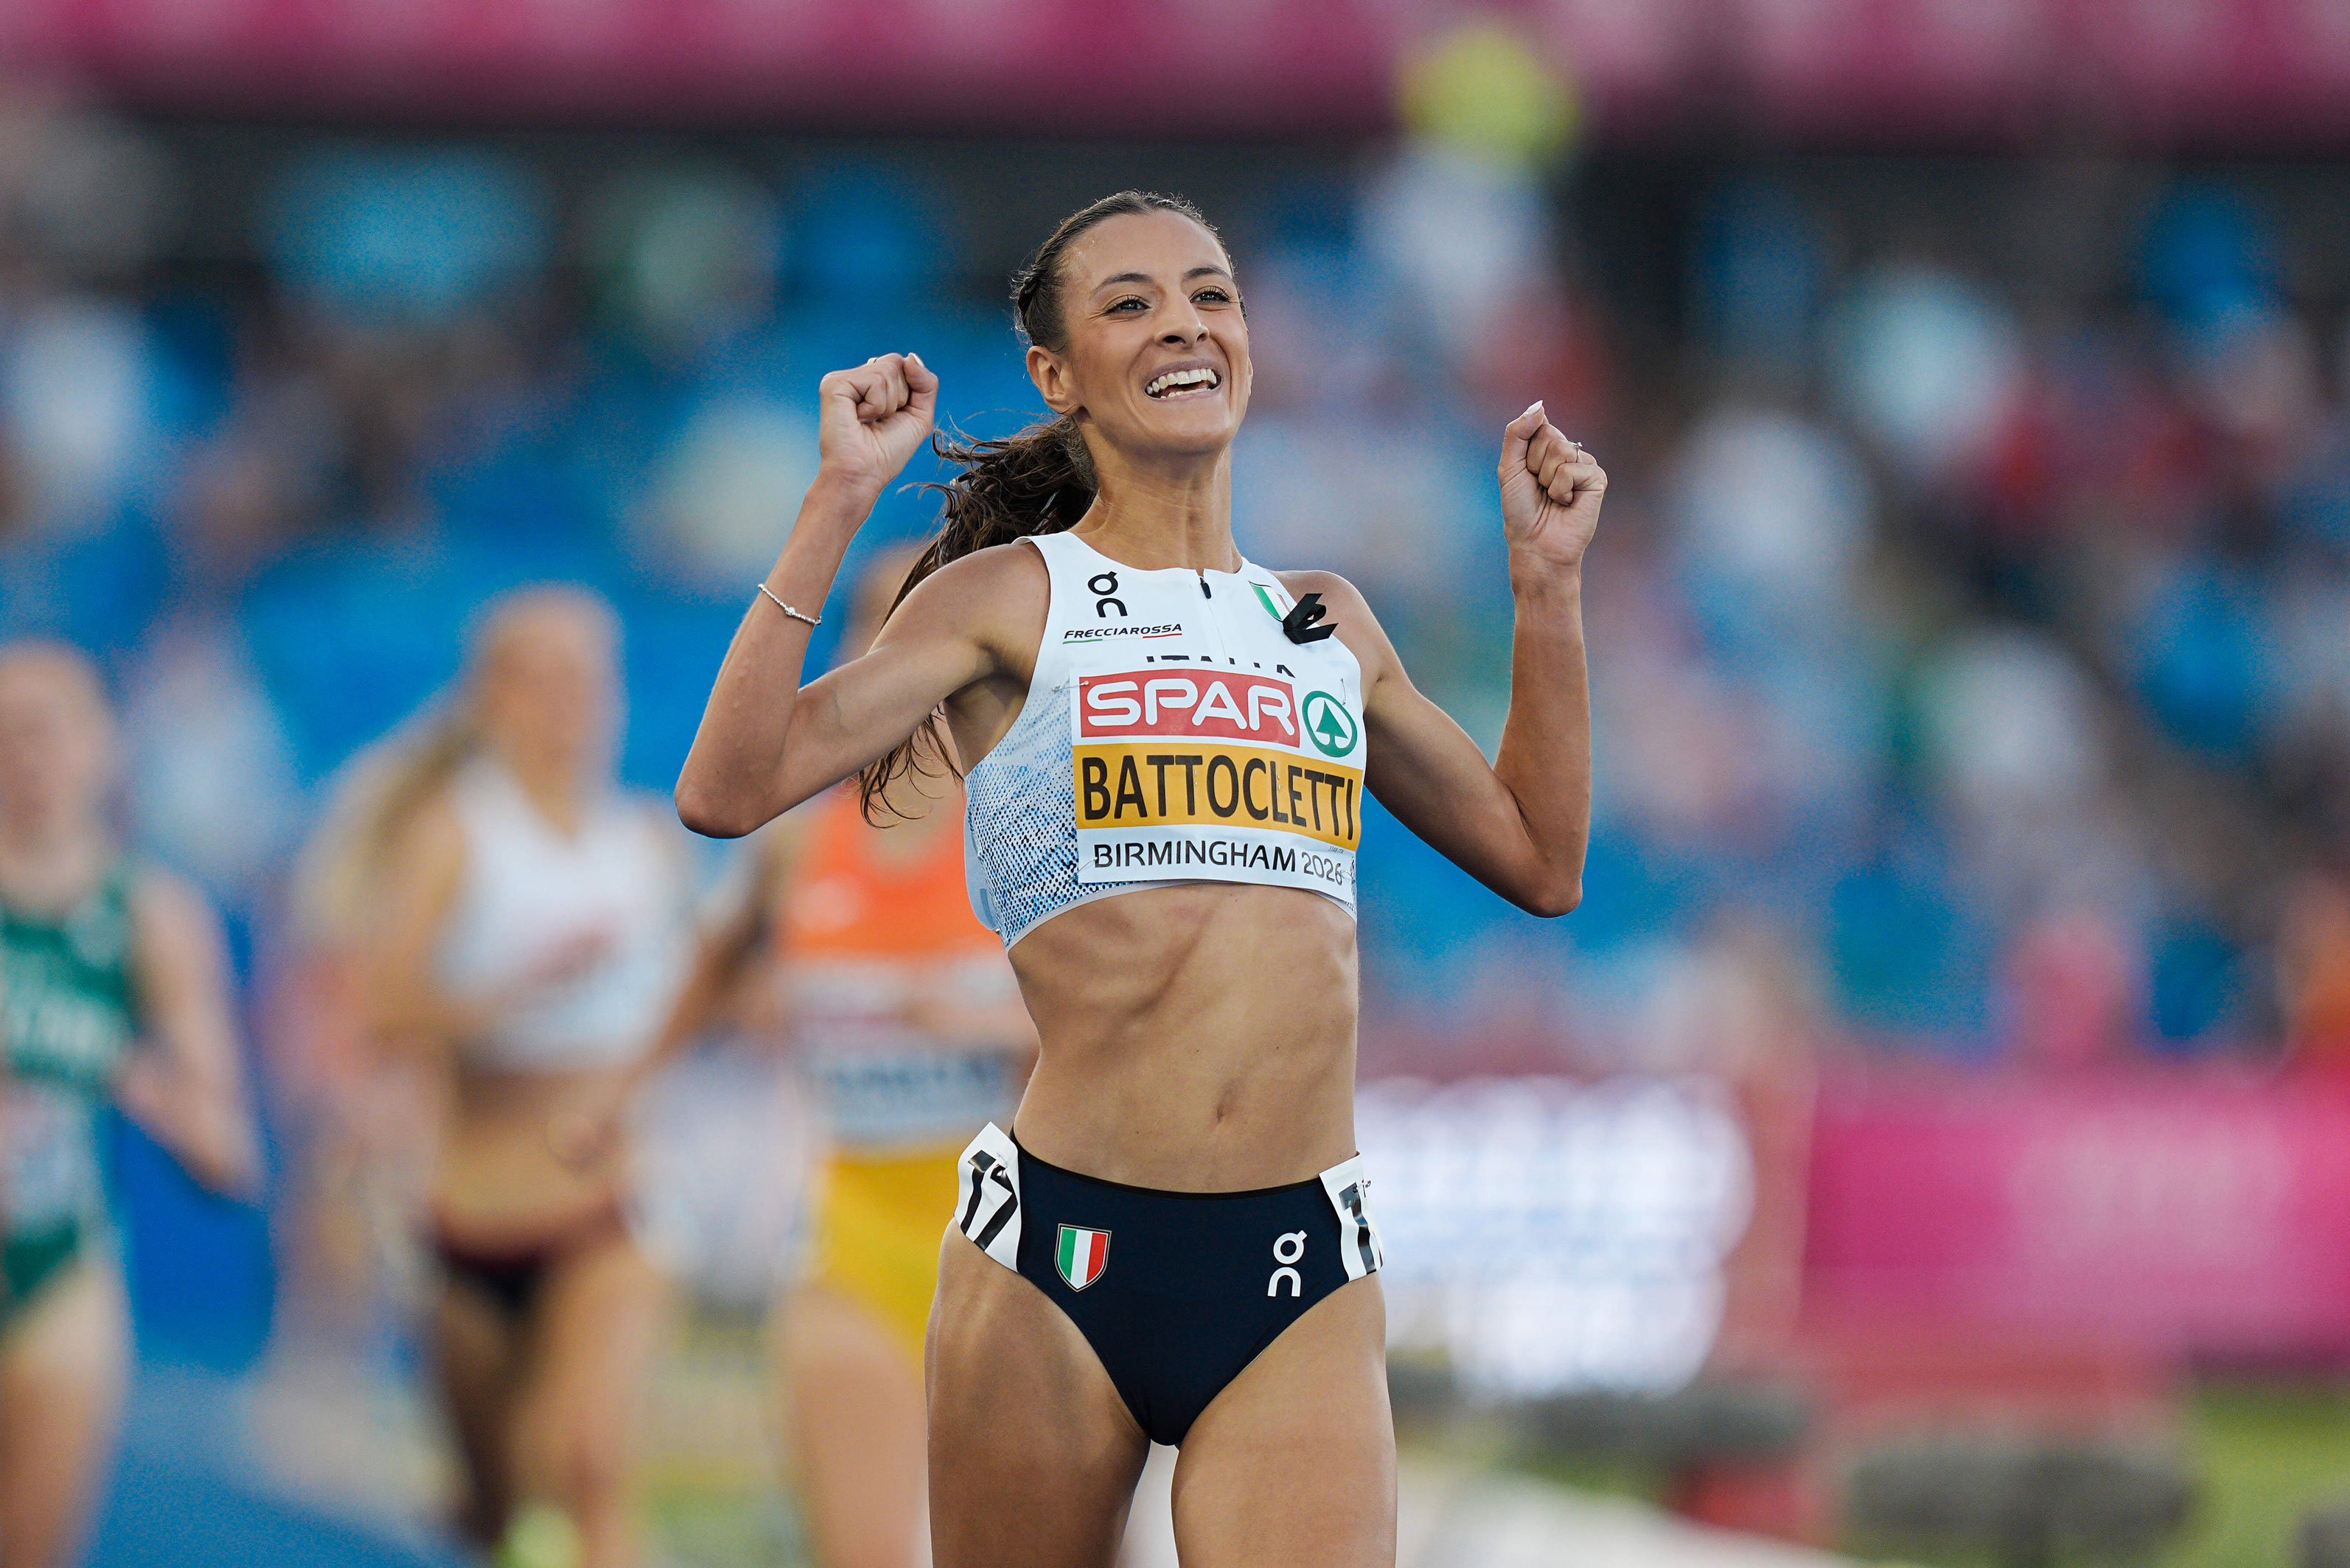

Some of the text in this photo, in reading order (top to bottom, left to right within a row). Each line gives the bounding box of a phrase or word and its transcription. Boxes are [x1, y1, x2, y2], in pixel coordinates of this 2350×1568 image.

[1064, 624, 1182, 639] FRECCIAROSSA
[1087, 678, 1295, 736] SPAR
[1081, 755, 1353, 840] BATTOCLETTI
[1093, 840, 1342, 886] BIRMINGHAM 2026
